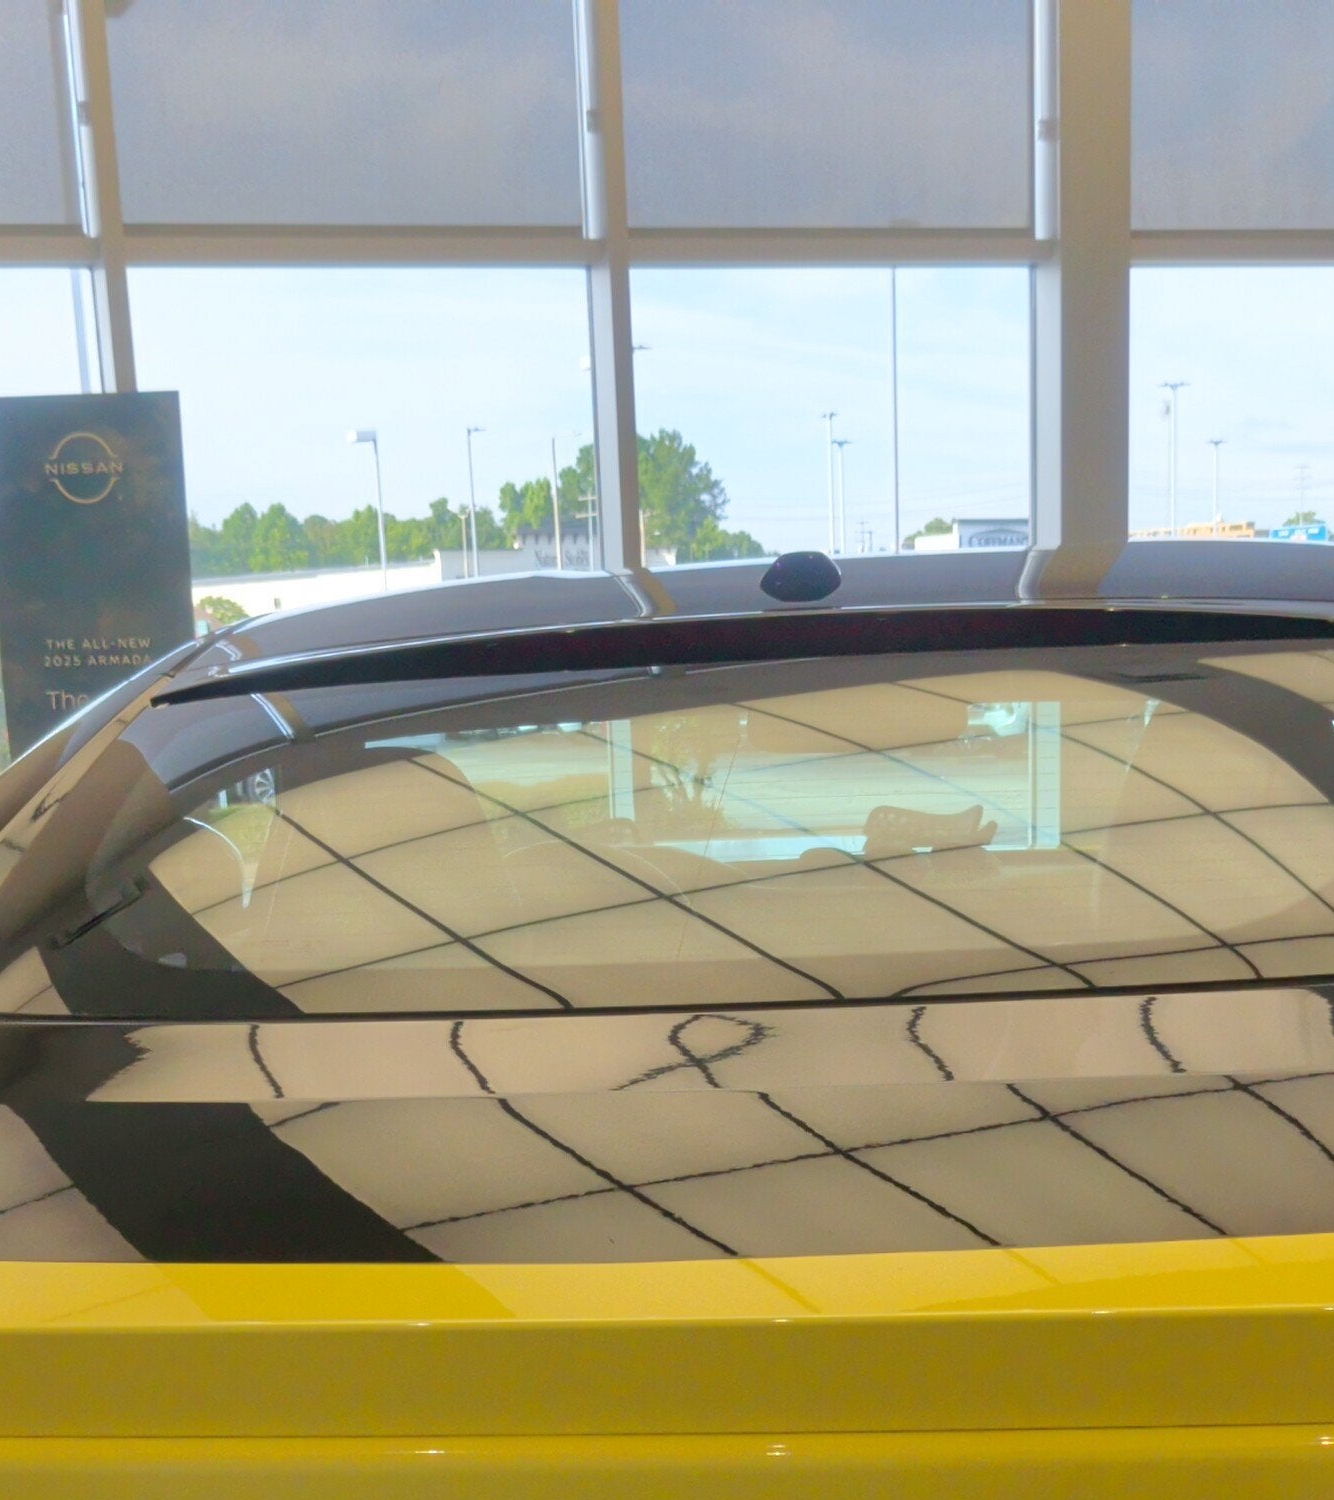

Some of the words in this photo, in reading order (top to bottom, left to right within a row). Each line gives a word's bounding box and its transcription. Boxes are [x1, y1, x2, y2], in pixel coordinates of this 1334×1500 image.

[44, 461, 124, 476] NISSAN
[45, 638, 75, 650] THE
[82, 637, 152, 649] ALL-NEW
[43, 655, 81, 667] 2025
[88, 654, 152, 666] ARMADA
